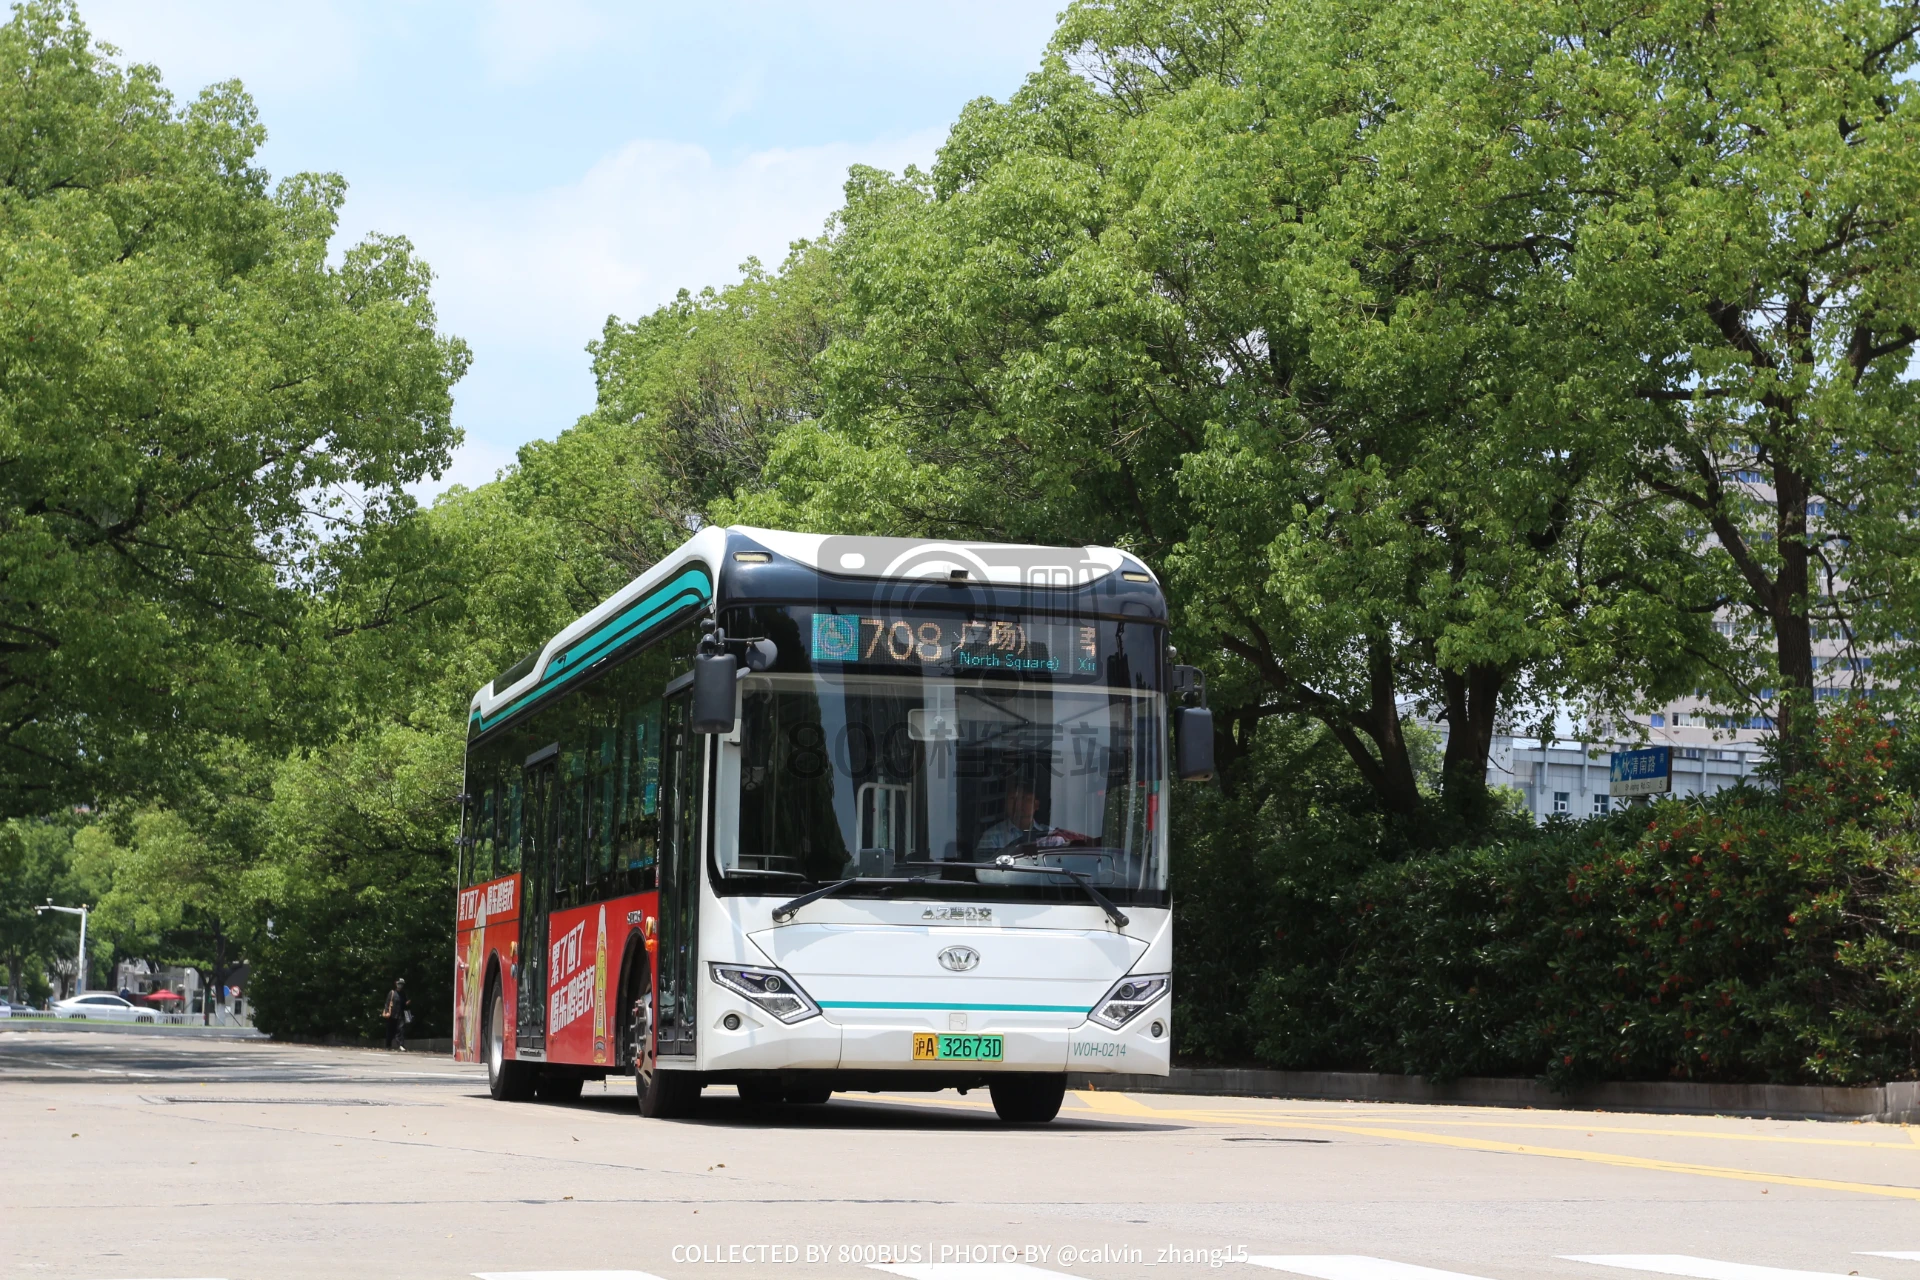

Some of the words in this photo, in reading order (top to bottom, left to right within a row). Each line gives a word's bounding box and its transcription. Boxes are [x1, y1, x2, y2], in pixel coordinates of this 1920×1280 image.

[860, 618, 943, 662] 708
[959, 651, 1000, 667] North
[1005, 653, 1060, 671] Square)
[942, 1037, 1001, 1058] 32673D
